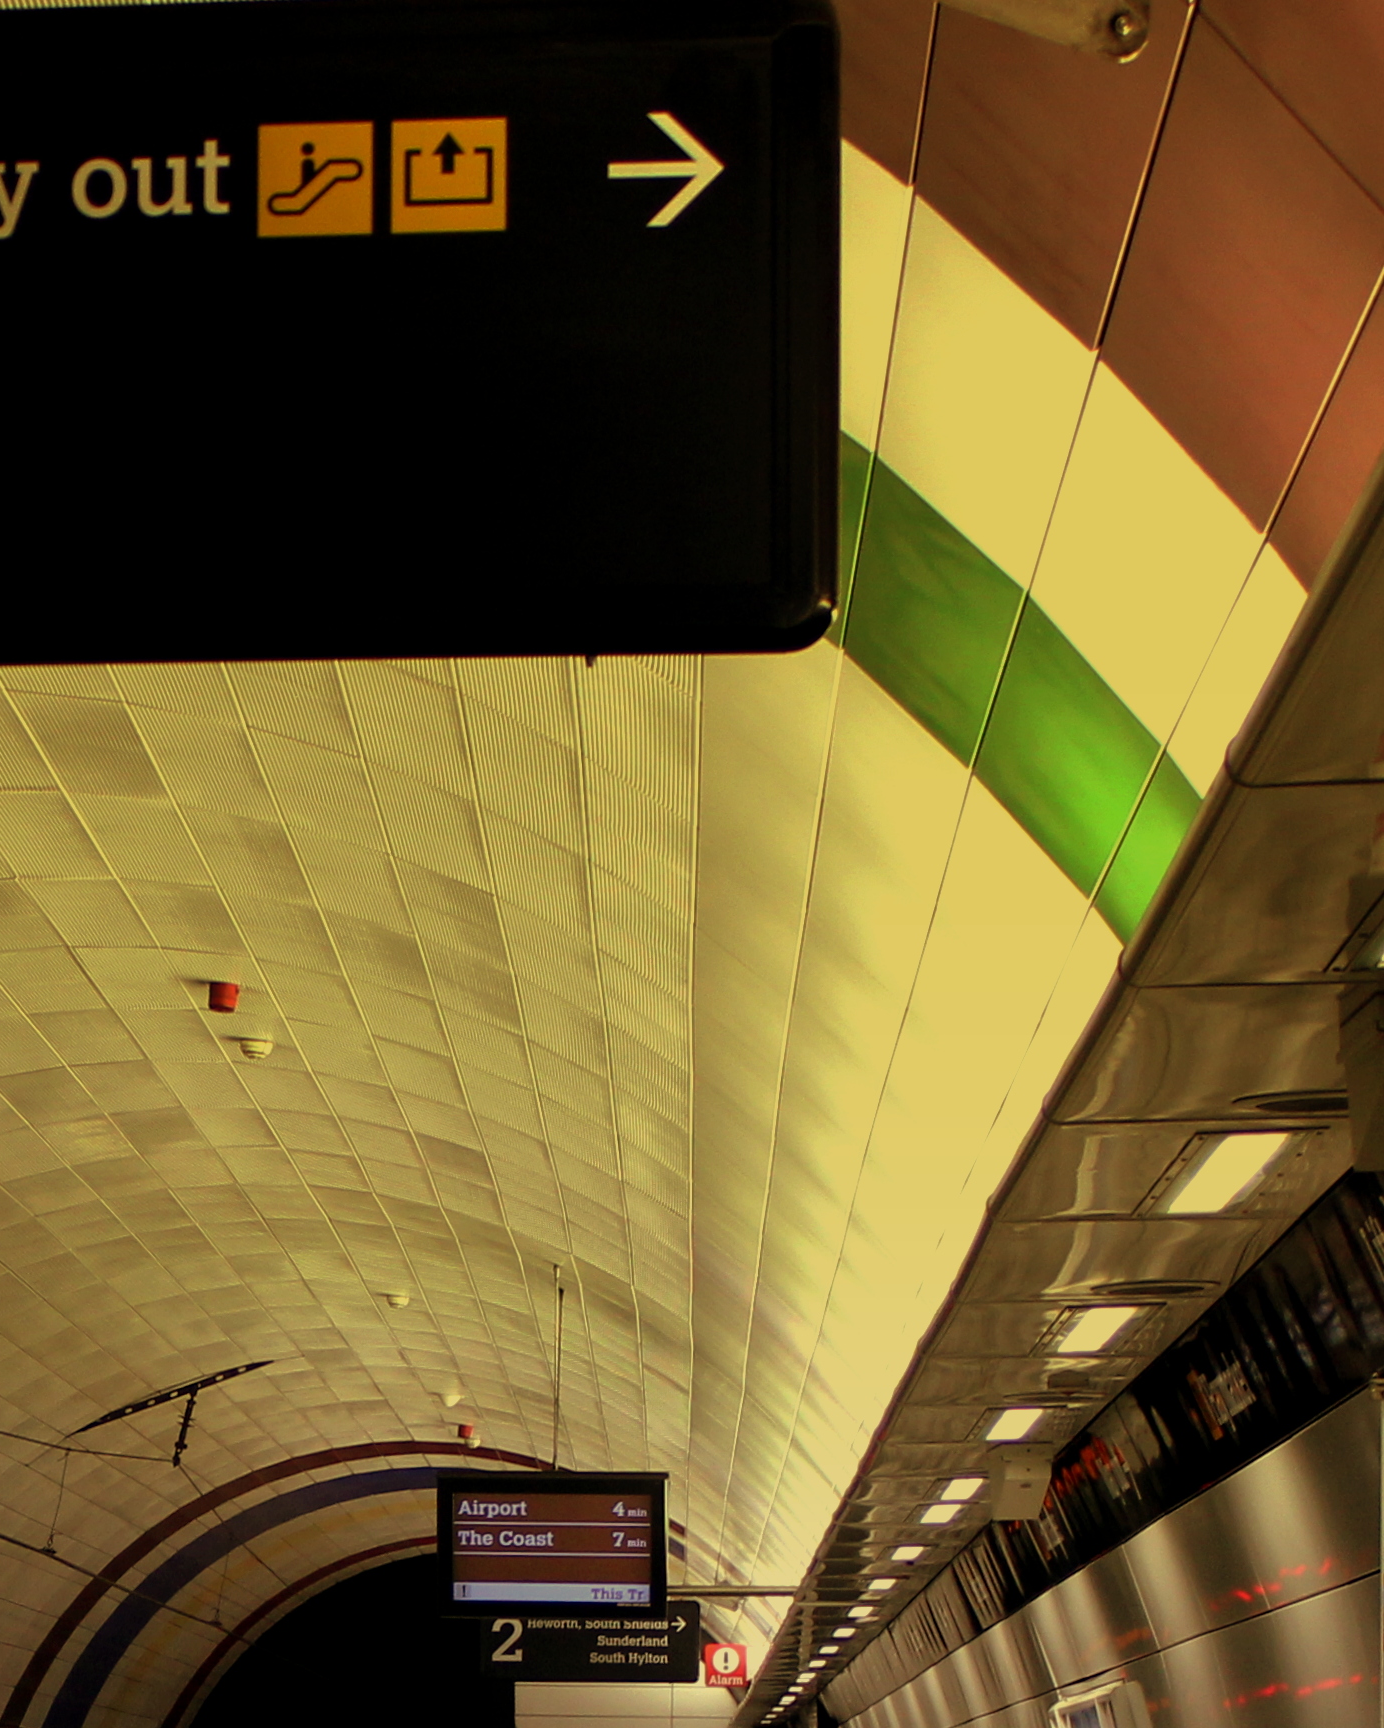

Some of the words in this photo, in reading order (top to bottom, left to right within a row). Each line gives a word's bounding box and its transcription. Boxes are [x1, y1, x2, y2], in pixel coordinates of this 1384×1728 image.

[71, 140, 231, 220] out
[458, 1499, 527, 1518] Airport
[612, 1501, 625, 1517] 4
[627, 1508, 647, 1517] min
[458, 1530, 494, 1546] The
[499, 1530, 554, 1547] Coast
[612, 1531, 625, 1547] 7
[627, 1538, 647, 1548] min
[591, 1587, 624, 1600] This
[585, 1619, 621, 1630] South
[491, 1618, 523, 1662] 2
[597, 1635, 669, 1647] Sunderland
[589, 1652, 626, 1664] South
[628, 1652, 669, 1666] Hylton
[708, 1675, 744, 1686] Alarm
